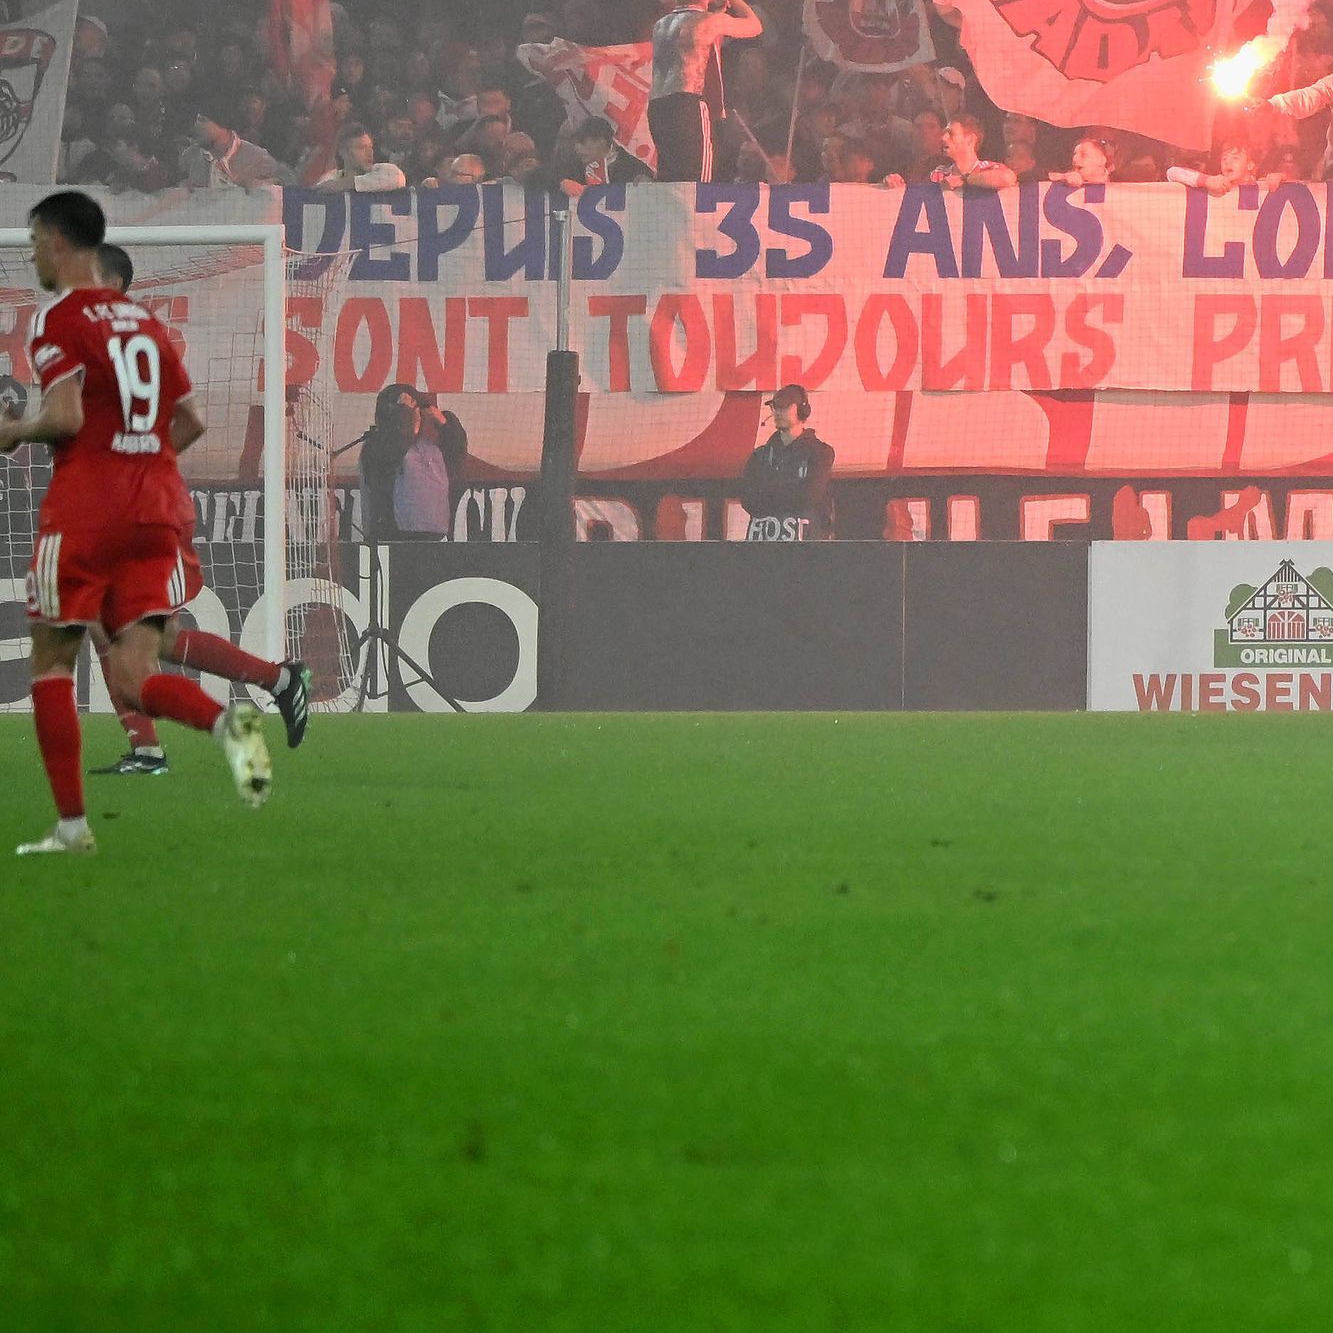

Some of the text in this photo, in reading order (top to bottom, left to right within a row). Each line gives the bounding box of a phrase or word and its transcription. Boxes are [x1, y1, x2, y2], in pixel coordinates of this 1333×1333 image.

[283, 185, 626, 282] DEPUIS
[696, 181, 833, 279] 35
[883, 182, 1132, 279] ANS,
[107, 332, 161, 433] 19
[257, 294, 529, 393] SONT
[588, 293, 1124, 393] TOUJOURS
[1239, 647, 1332, 666] ORIGINAL
